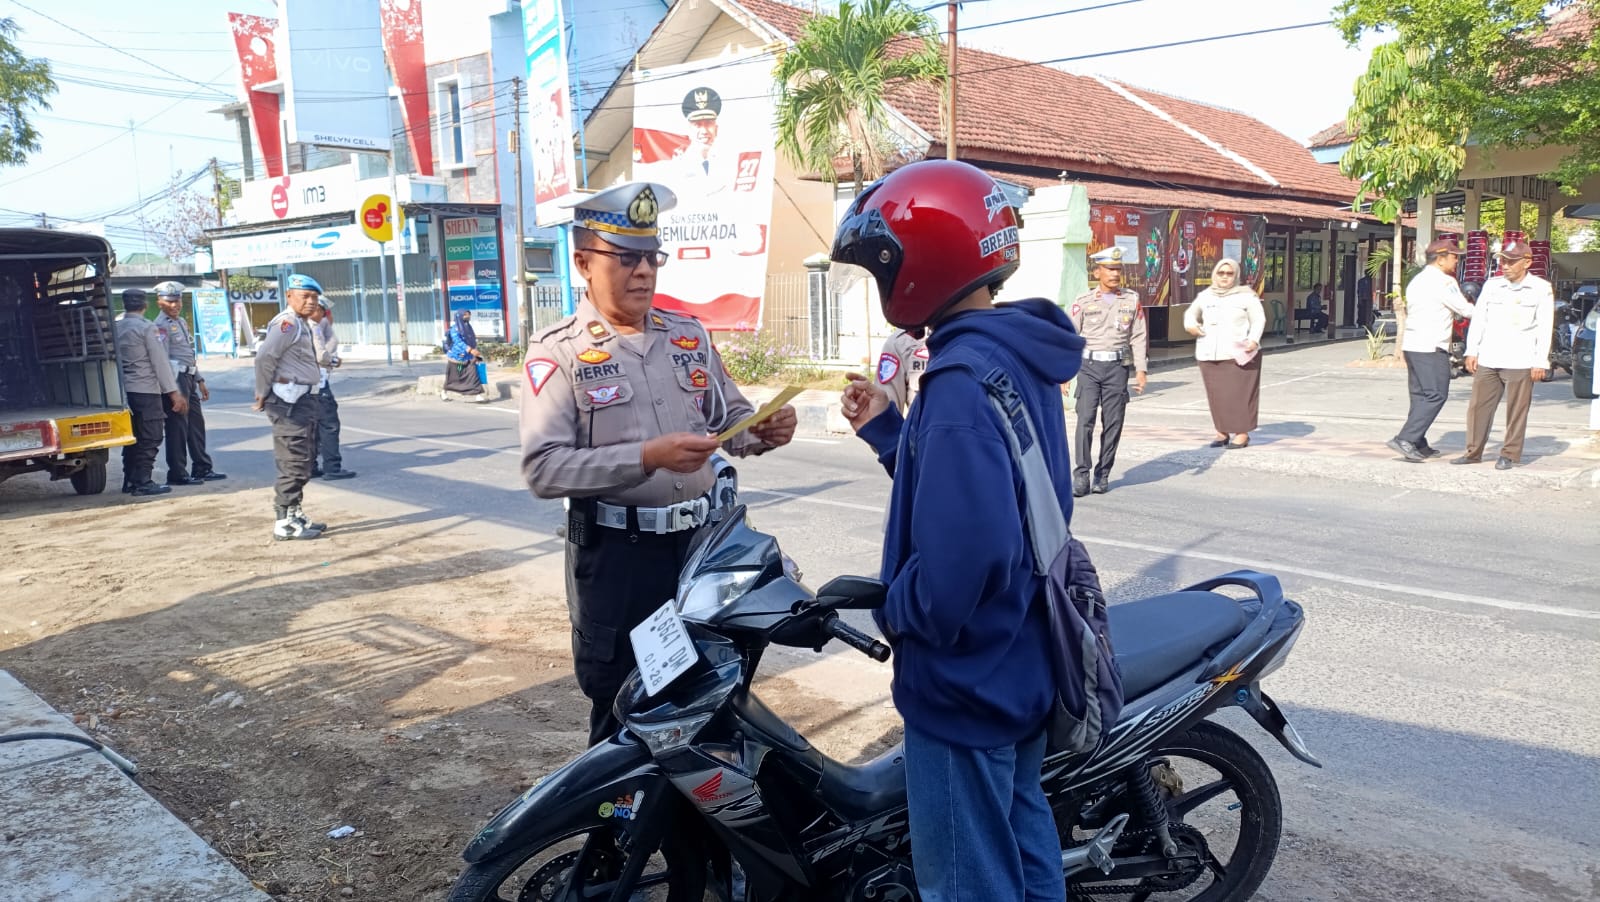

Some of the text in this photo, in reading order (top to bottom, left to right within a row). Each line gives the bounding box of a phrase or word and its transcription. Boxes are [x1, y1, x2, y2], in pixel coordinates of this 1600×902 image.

[313, 134, 376, 146] SHELYN CELL
[445, 218, 478, 235] SHELYN
[672, 352, 707, 365] POLRI
[574, 363, 619, 382] HERRY
[654, 606, 670, 622] S
[657, 617, 681, 649] 6641
